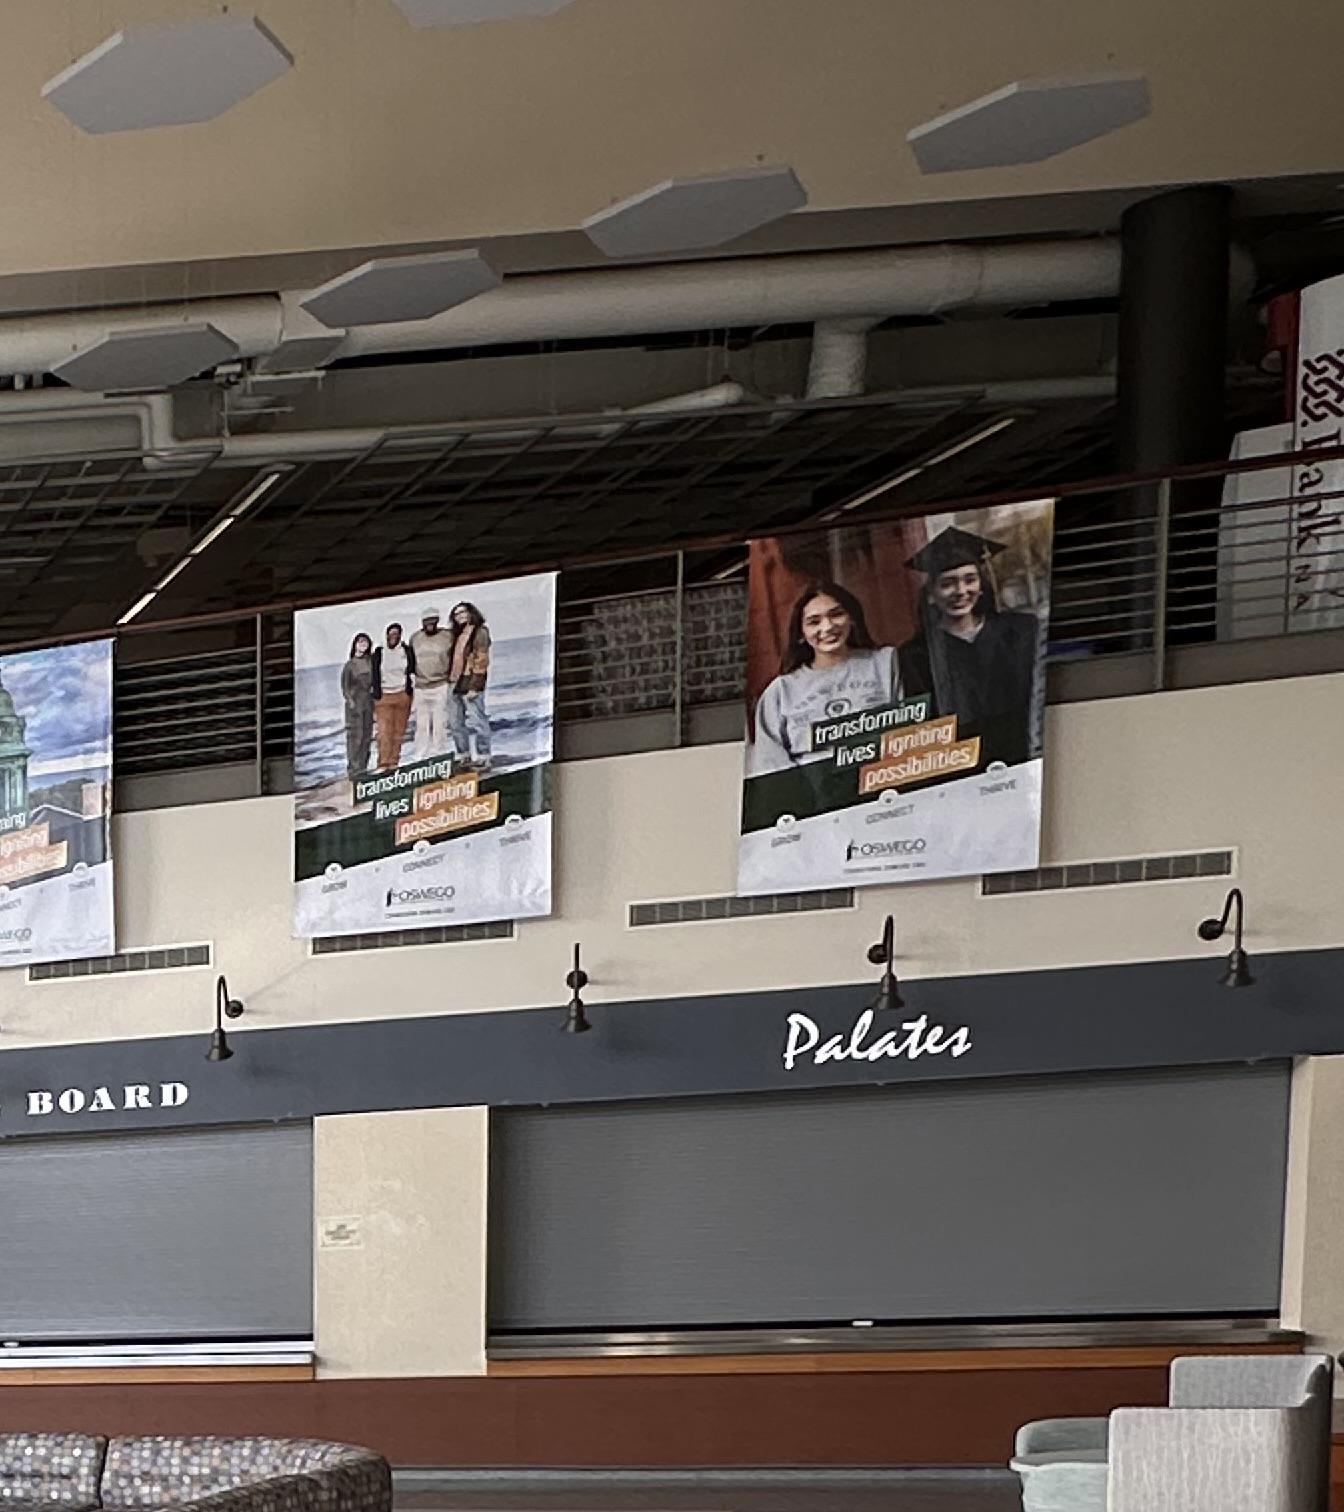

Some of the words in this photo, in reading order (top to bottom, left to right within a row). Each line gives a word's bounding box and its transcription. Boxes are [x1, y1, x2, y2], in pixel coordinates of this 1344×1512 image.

[815, 702, 927, 743] transforming
[837, 741, 876, 767] lives
[888, 723, 954, 757] igniting
[357, 760, 452, 799] transforming
[865, 747, 971, 789] possibilities
[376, 796, 409, 819] lives
[420, 780, 476, 810] igniting
[400, 801, 491, 839] possibilities
[861, 838, 927, 855] OSWEGO
[398, 886, 455, 902] OSWEGO
[783, 1009, 972, 1070] Palates
[26, 1082, 190, 1116] BOARD
